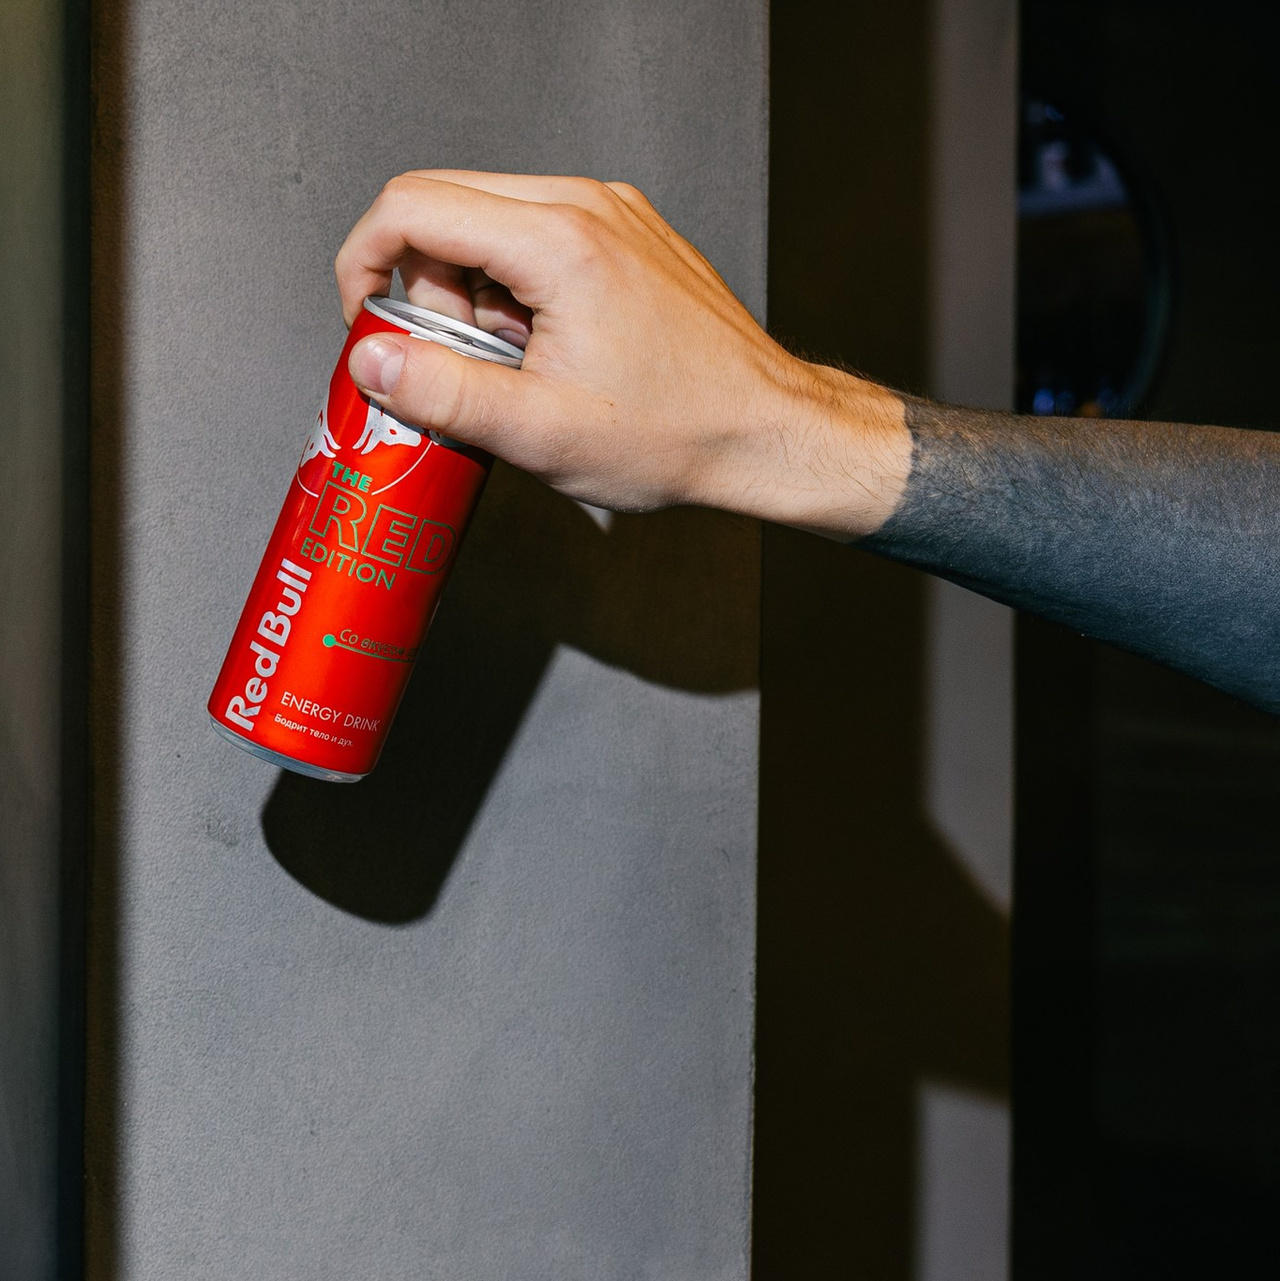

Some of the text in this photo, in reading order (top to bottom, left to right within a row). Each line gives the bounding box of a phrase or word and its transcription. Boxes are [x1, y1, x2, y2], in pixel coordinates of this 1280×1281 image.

[332, 461, 373, 493] THE
[309, 480, 456, 575] RED
[300, 537, 396, 591] EDITION
[225, 558, 313, 732] Red Bull
[340, 628, 359, 645] Со
[274, 713, 308, 734] Бодрит
[309, 727, 330, 741] тело
[280, 691, 381, 732] ENERGY DRINK
